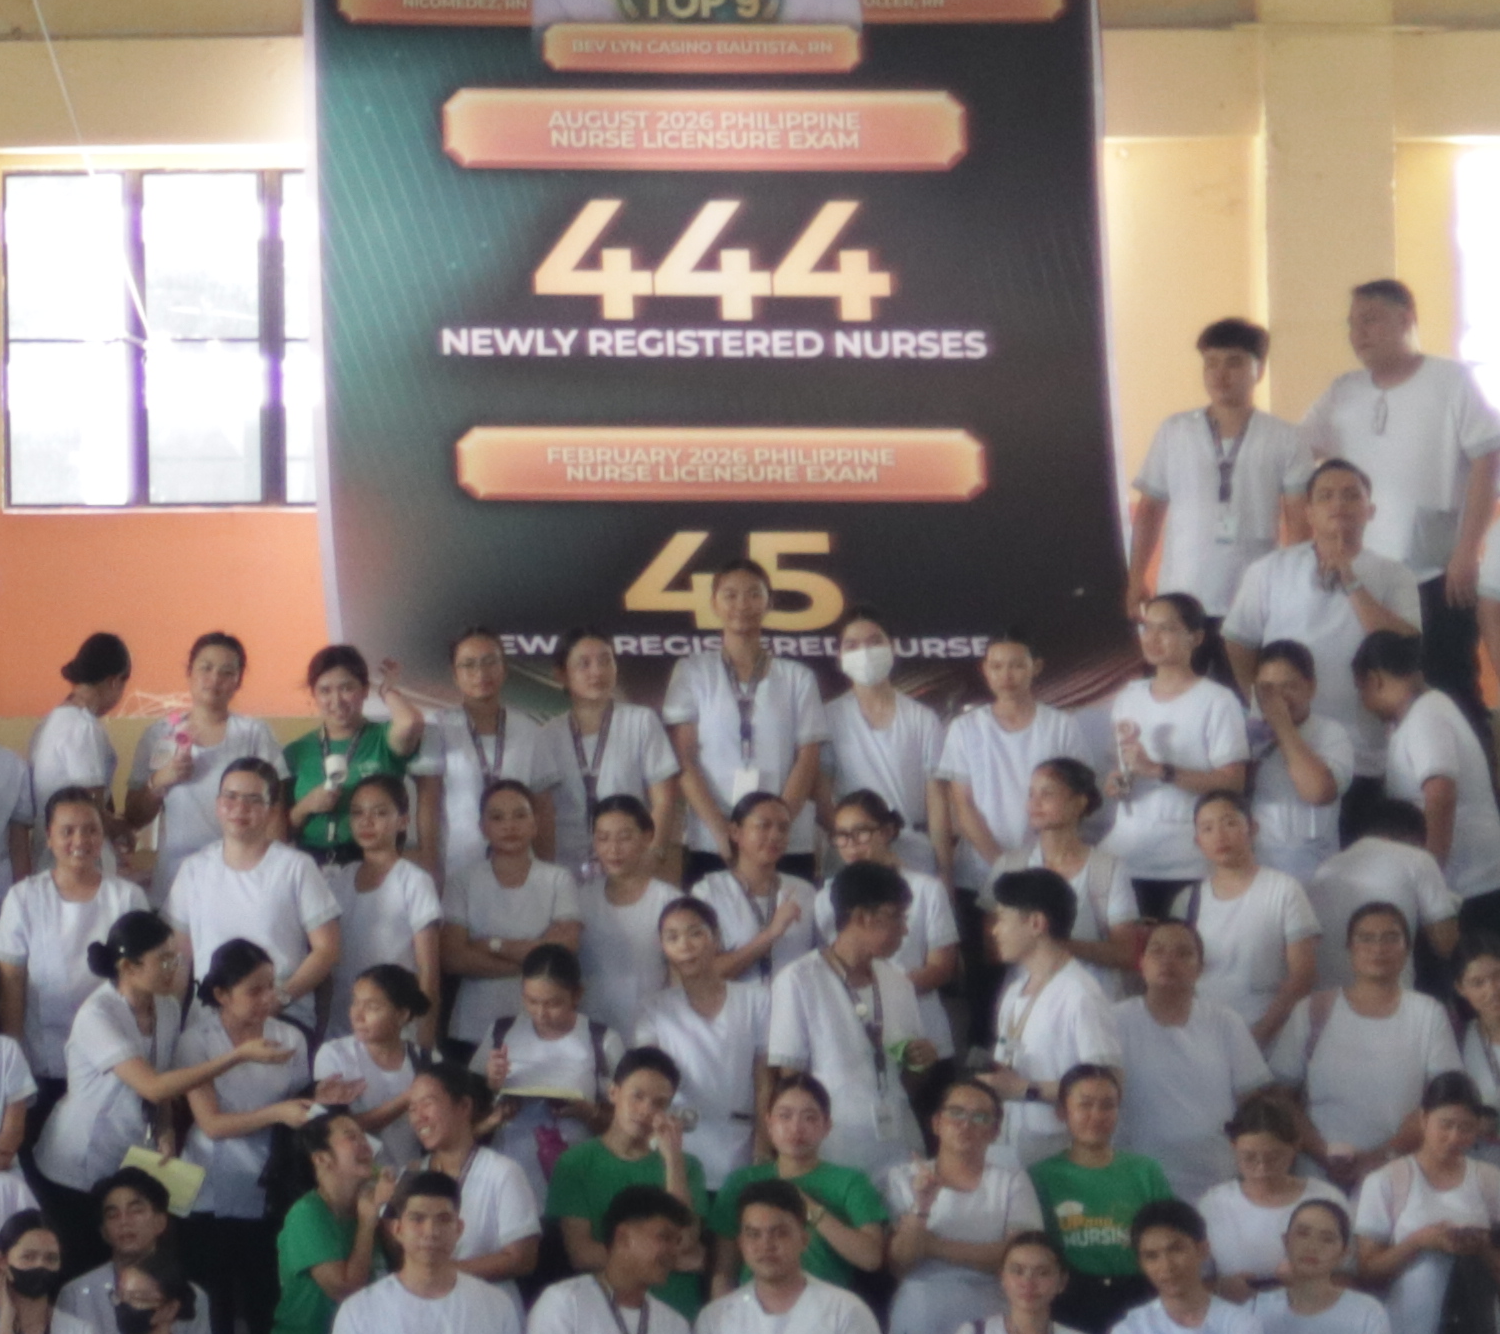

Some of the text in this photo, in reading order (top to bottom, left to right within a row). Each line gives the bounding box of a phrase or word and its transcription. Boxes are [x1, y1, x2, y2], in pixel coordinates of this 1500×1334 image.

[549, 112, 860, 130] AUGUST 2026 PHILIPPINE
[550, 130, 859, 149] NURSE LICENSURE EXAM
[533, 199, 891, 321] 444
[443, 328, 988, 359] NEWLY REGISTERED NURSES
[547, 447, 894, 466] FEBRUARY 2026 PHILIPPINE
[566, 465, 877, 484] NURSE LICENSURE EXAM
[623, 531, 843, 632] 45
